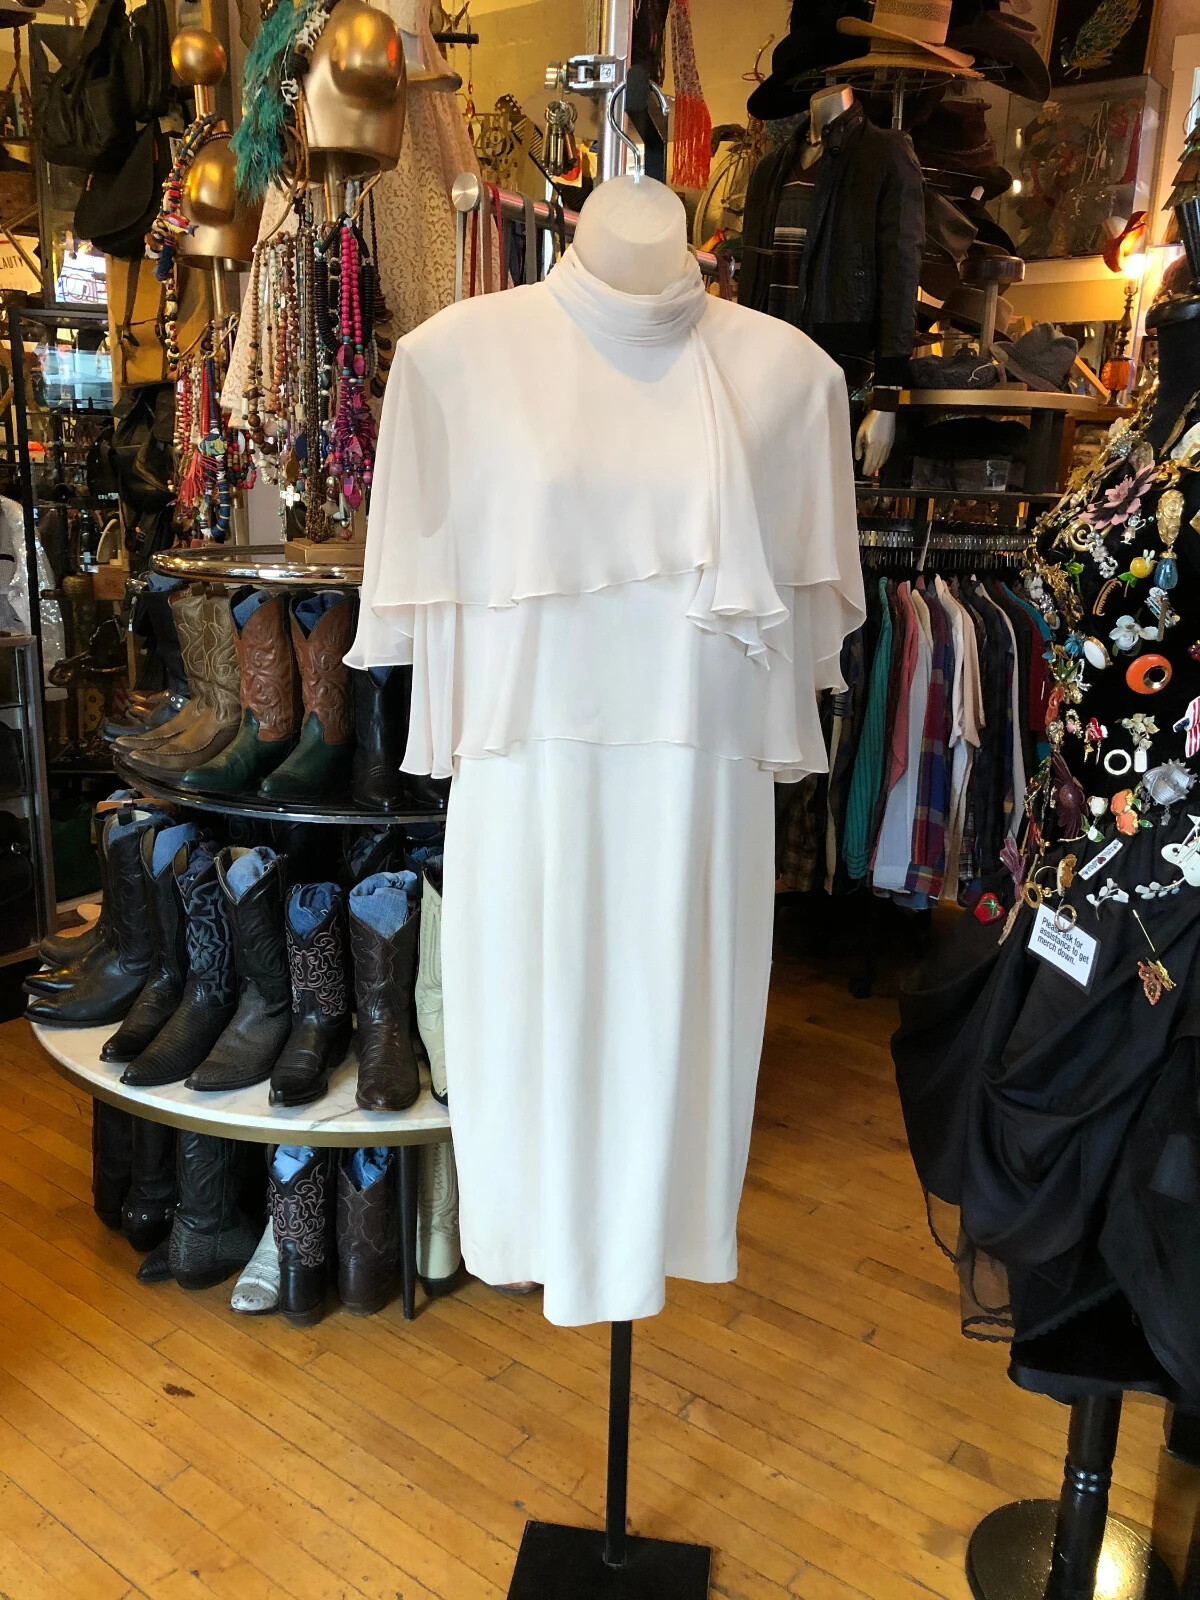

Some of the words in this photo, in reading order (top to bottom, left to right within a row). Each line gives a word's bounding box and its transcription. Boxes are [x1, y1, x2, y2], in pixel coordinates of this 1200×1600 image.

[0, 255, 24, 269] AUTY
[1037, 935, 1057, 952] merch
[1057, 947, 1075, 965] down.
[1040, 927, 1071, 951] assistance
[1072, 946, 1079, 956] to
[1079, 952, 1090, 965] get
[1062, 931, 1073, 944] ask
[1074, 937, 1084, 949] for
